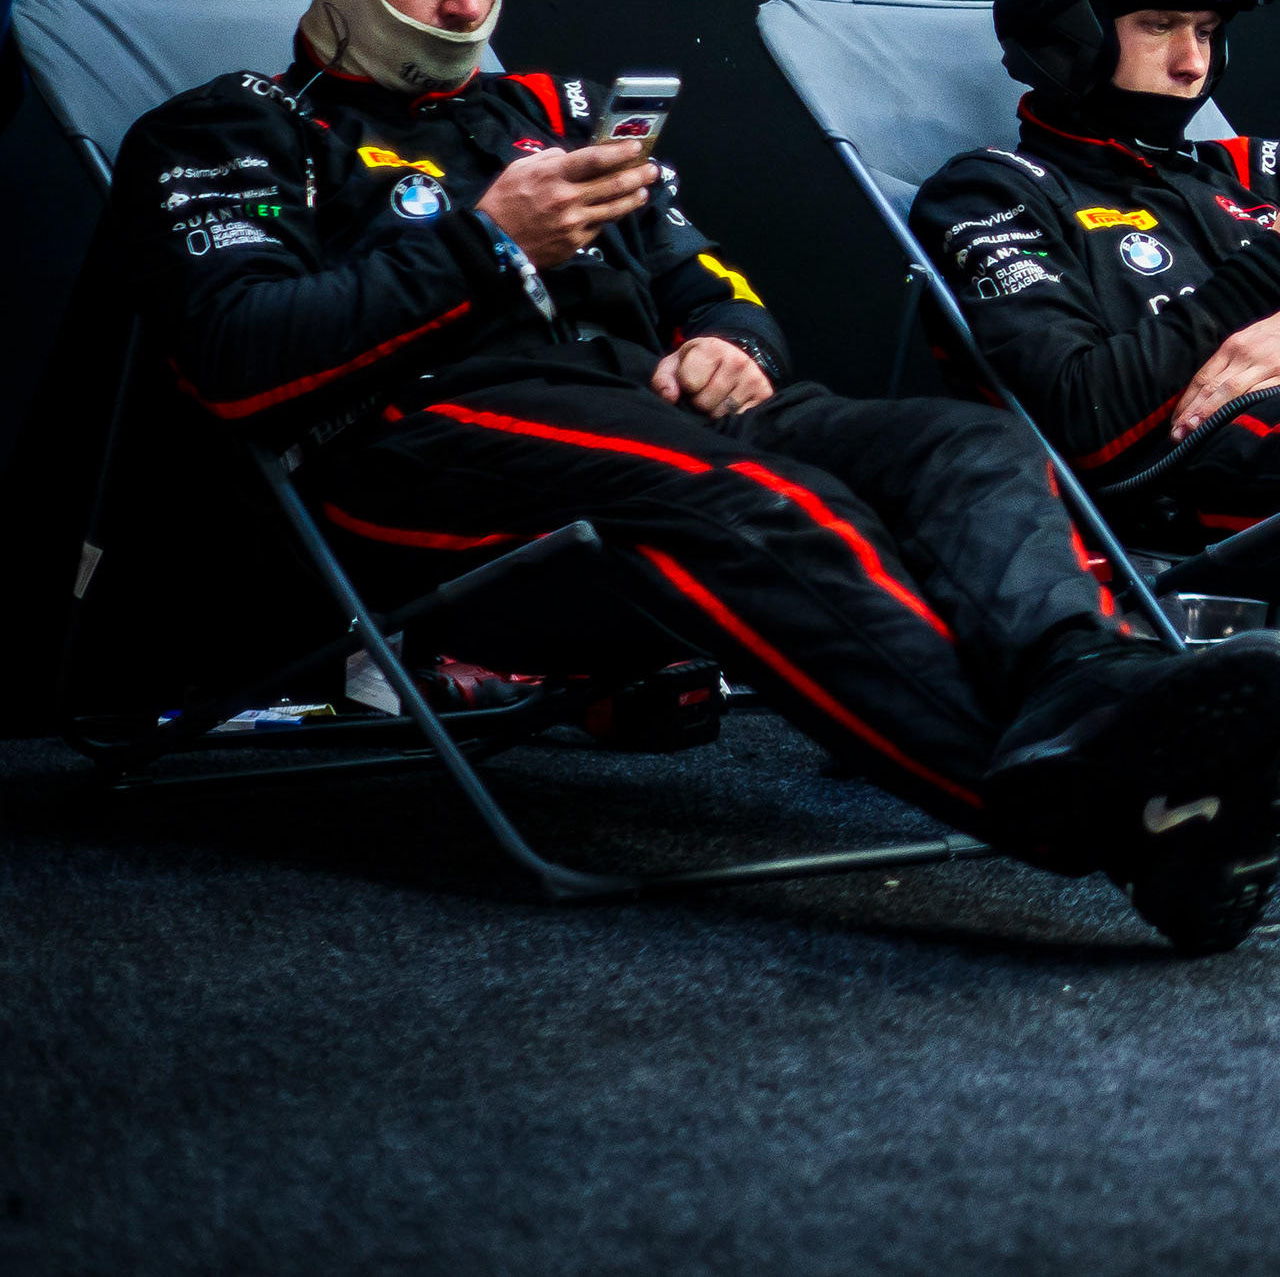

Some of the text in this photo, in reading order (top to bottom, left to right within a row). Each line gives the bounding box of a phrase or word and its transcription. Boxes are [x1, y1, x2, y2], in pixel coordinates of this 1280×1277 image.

[396, 176, 442, 196] BMW
[1122, 234, 1159, 252] BMW
[995, 259, 1038, 280] GLOBAL
